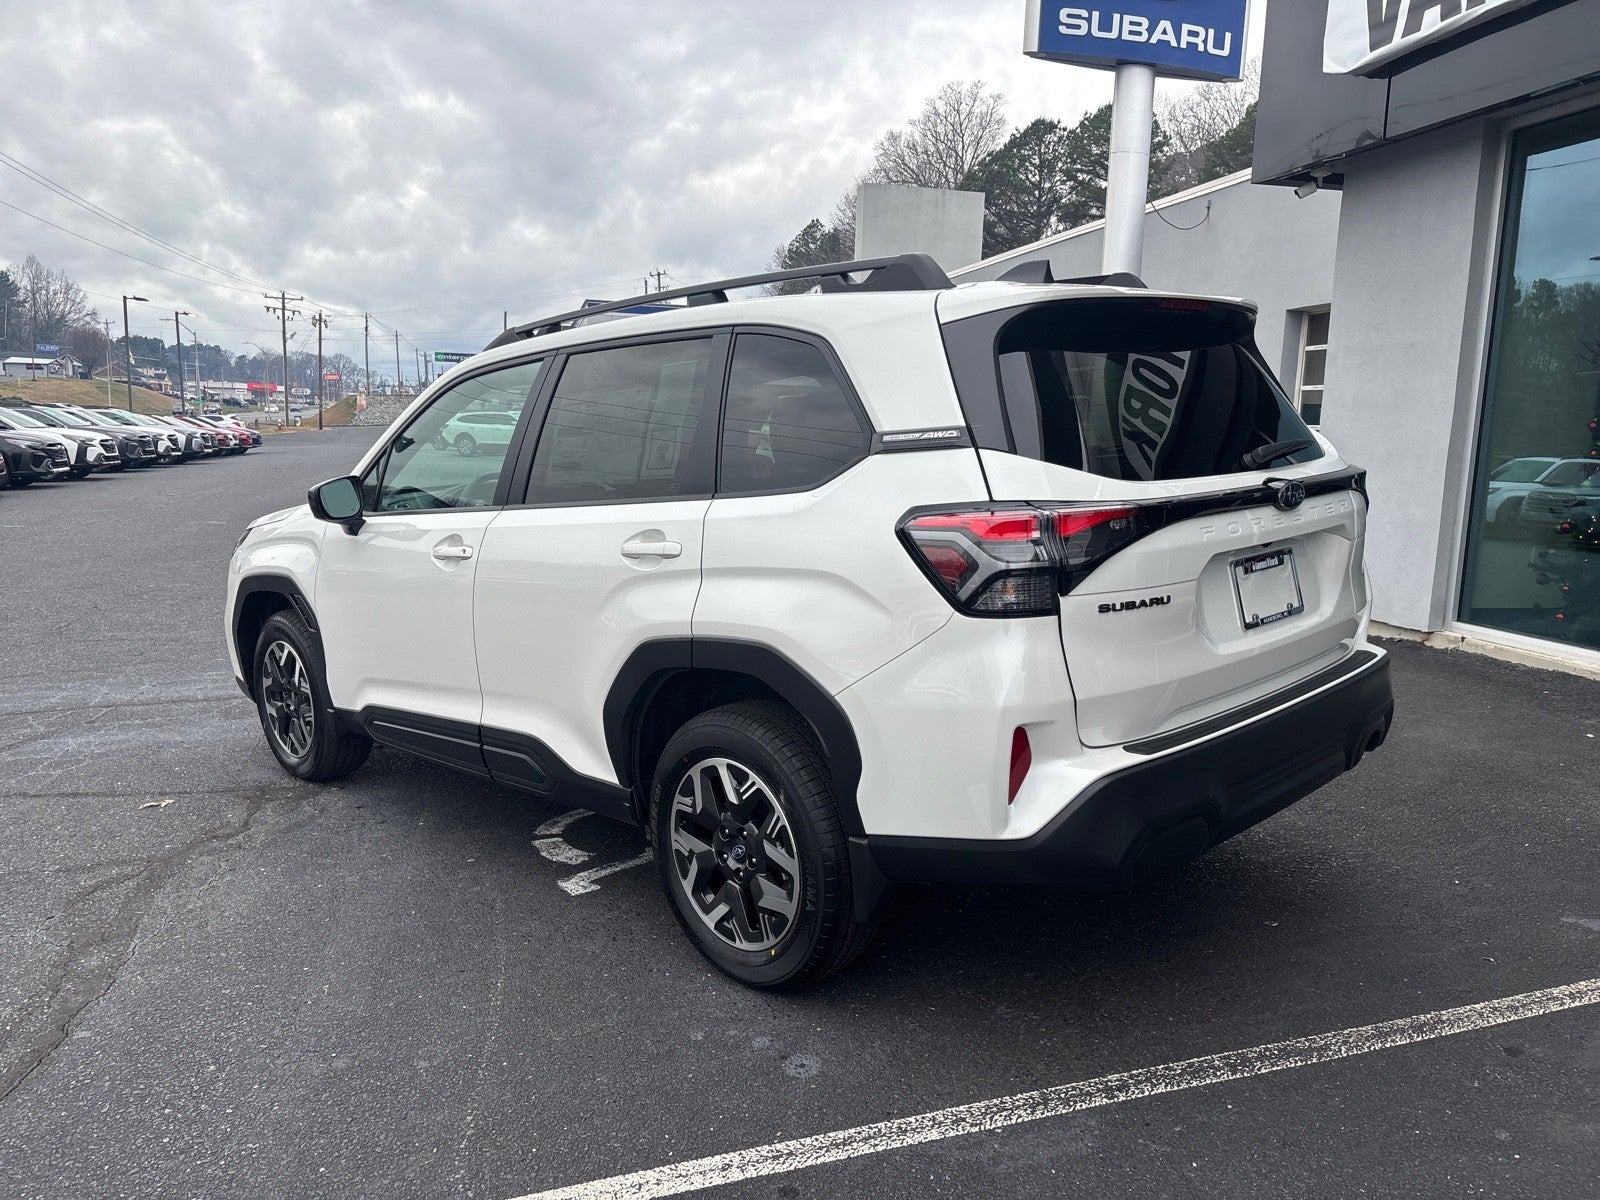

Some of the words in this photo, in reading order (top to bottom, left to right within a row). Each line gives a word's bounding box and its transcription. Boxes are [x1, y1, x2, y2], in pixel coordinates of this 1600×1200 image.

[1058, 7, 1232, 57] SUBARU
[1365, 0, 1488, 53] VA
[919, 429, 958, 440] AWD
[1200, 500, 1349, 542] FORESTER
[1097, 595, 1171, 613] SUBARU
